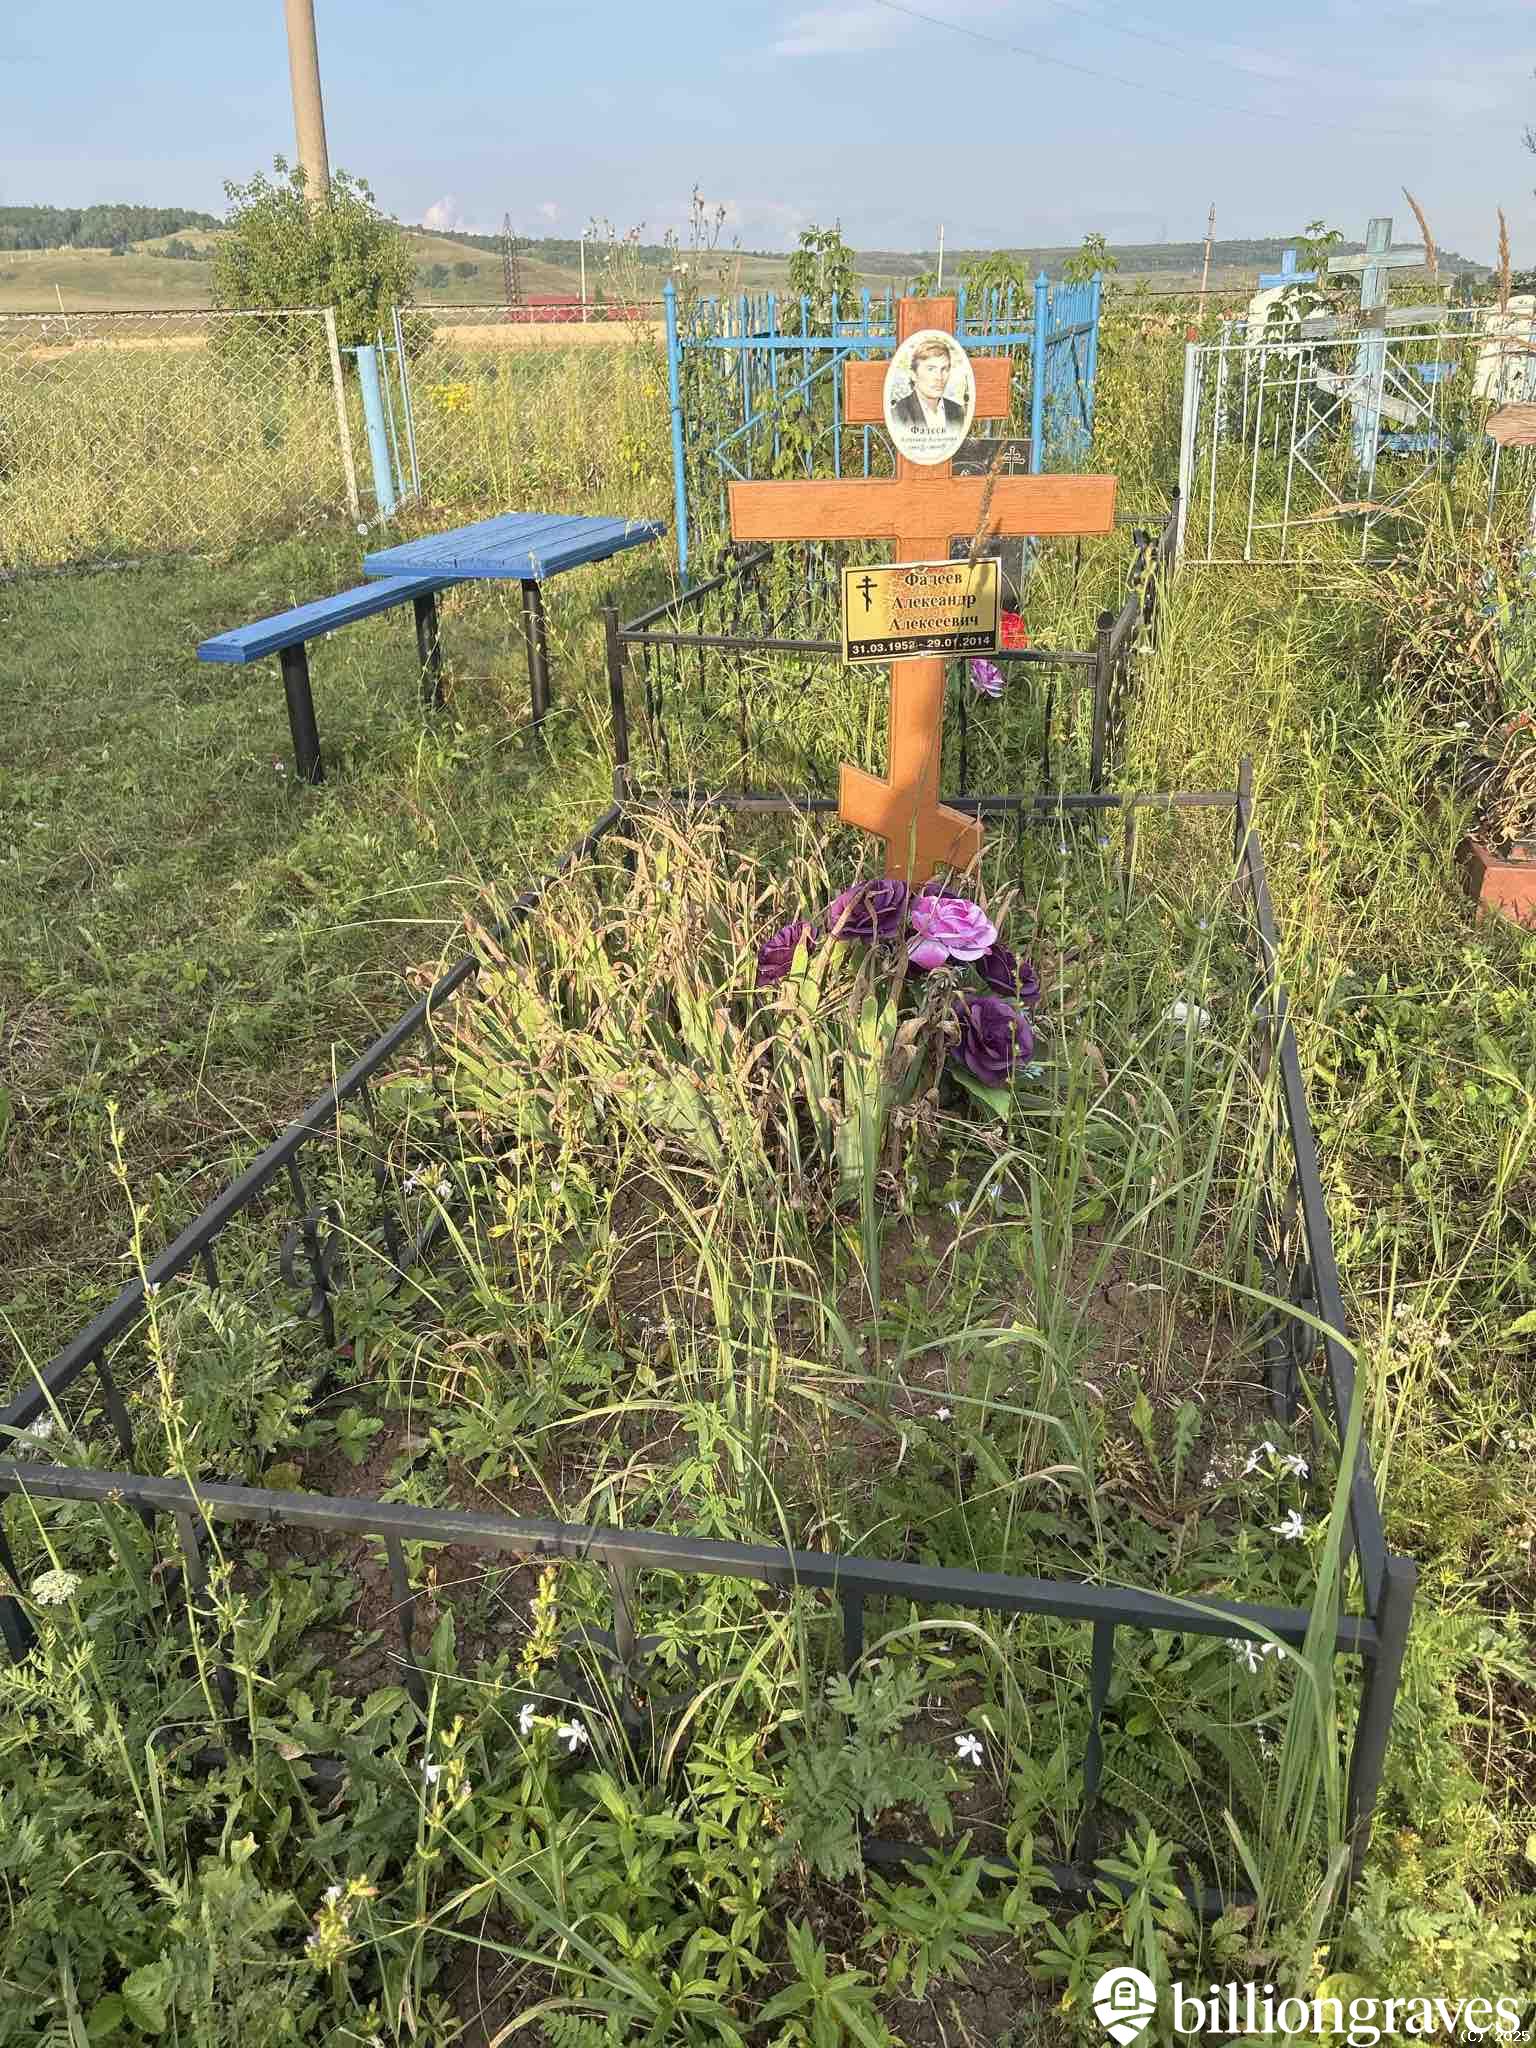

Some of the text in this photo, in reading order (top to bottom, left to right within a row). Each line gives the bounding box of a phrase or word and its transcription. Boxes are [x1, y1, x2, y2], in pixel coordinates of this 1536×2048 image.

[905, 572, 962, 586] Фадеев
[892, 593, 976, 609] Александр
[889, 615, 978, 631] Алексеевич
